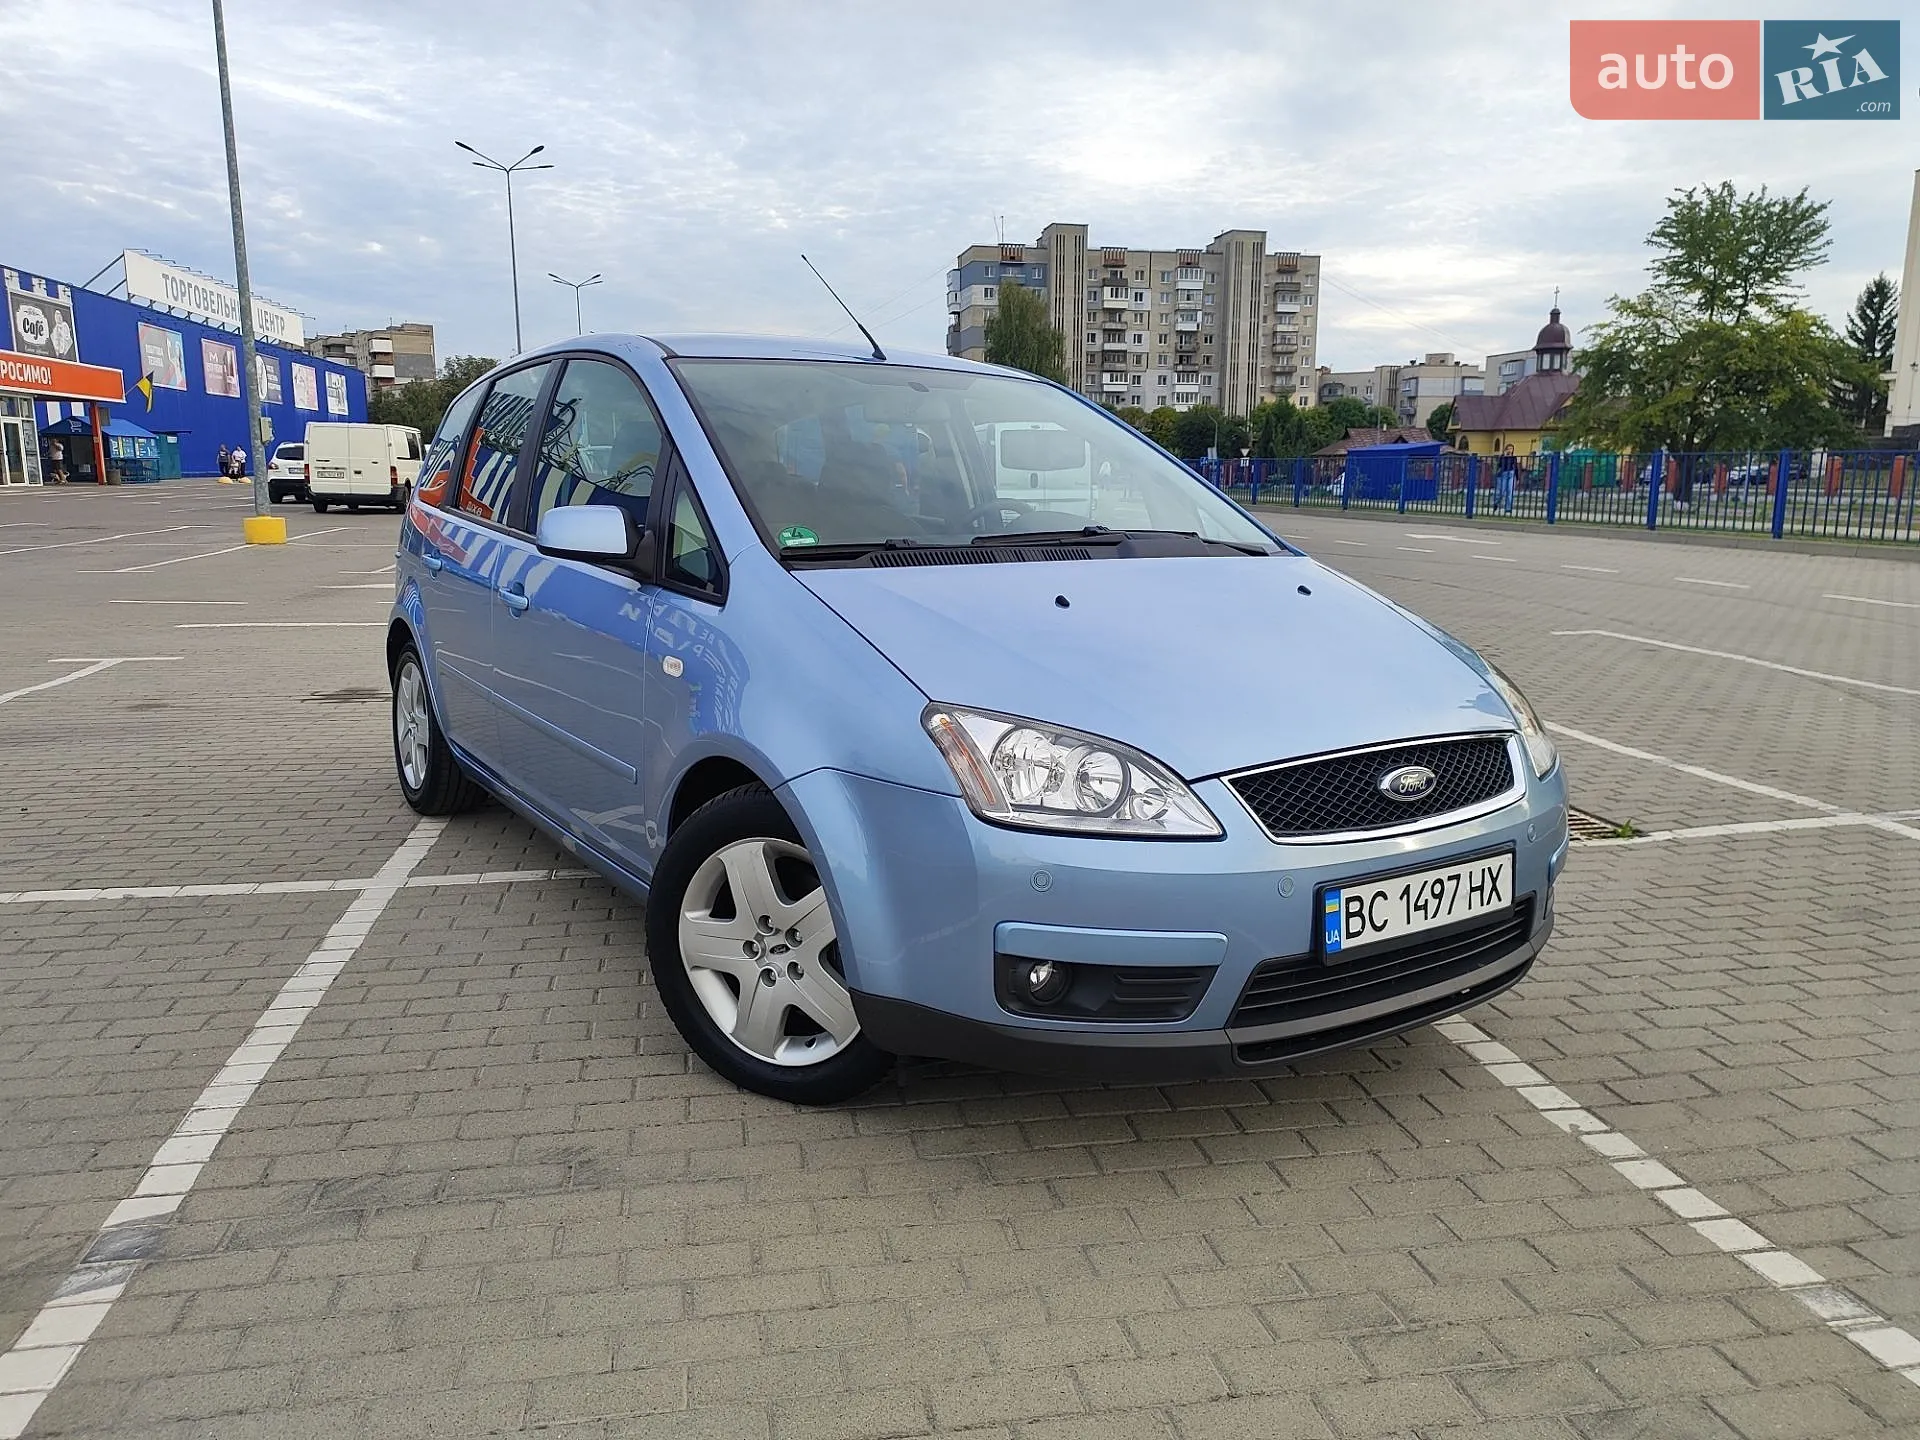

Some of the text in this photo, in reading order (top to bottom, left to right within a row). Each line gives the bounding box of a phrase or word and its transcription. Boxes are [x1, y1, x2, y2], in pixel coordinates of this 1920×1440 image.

[162, 273, 285, 337] ТОРГОВЕЛЬН ЦЕНТР
[23, 317, 44, 340] Café
[1400, 773, 1428, 793] Ford
[1344, 863, 1503, 940] BC 1497 HX
[1325, 930, 1340, 944] UA
